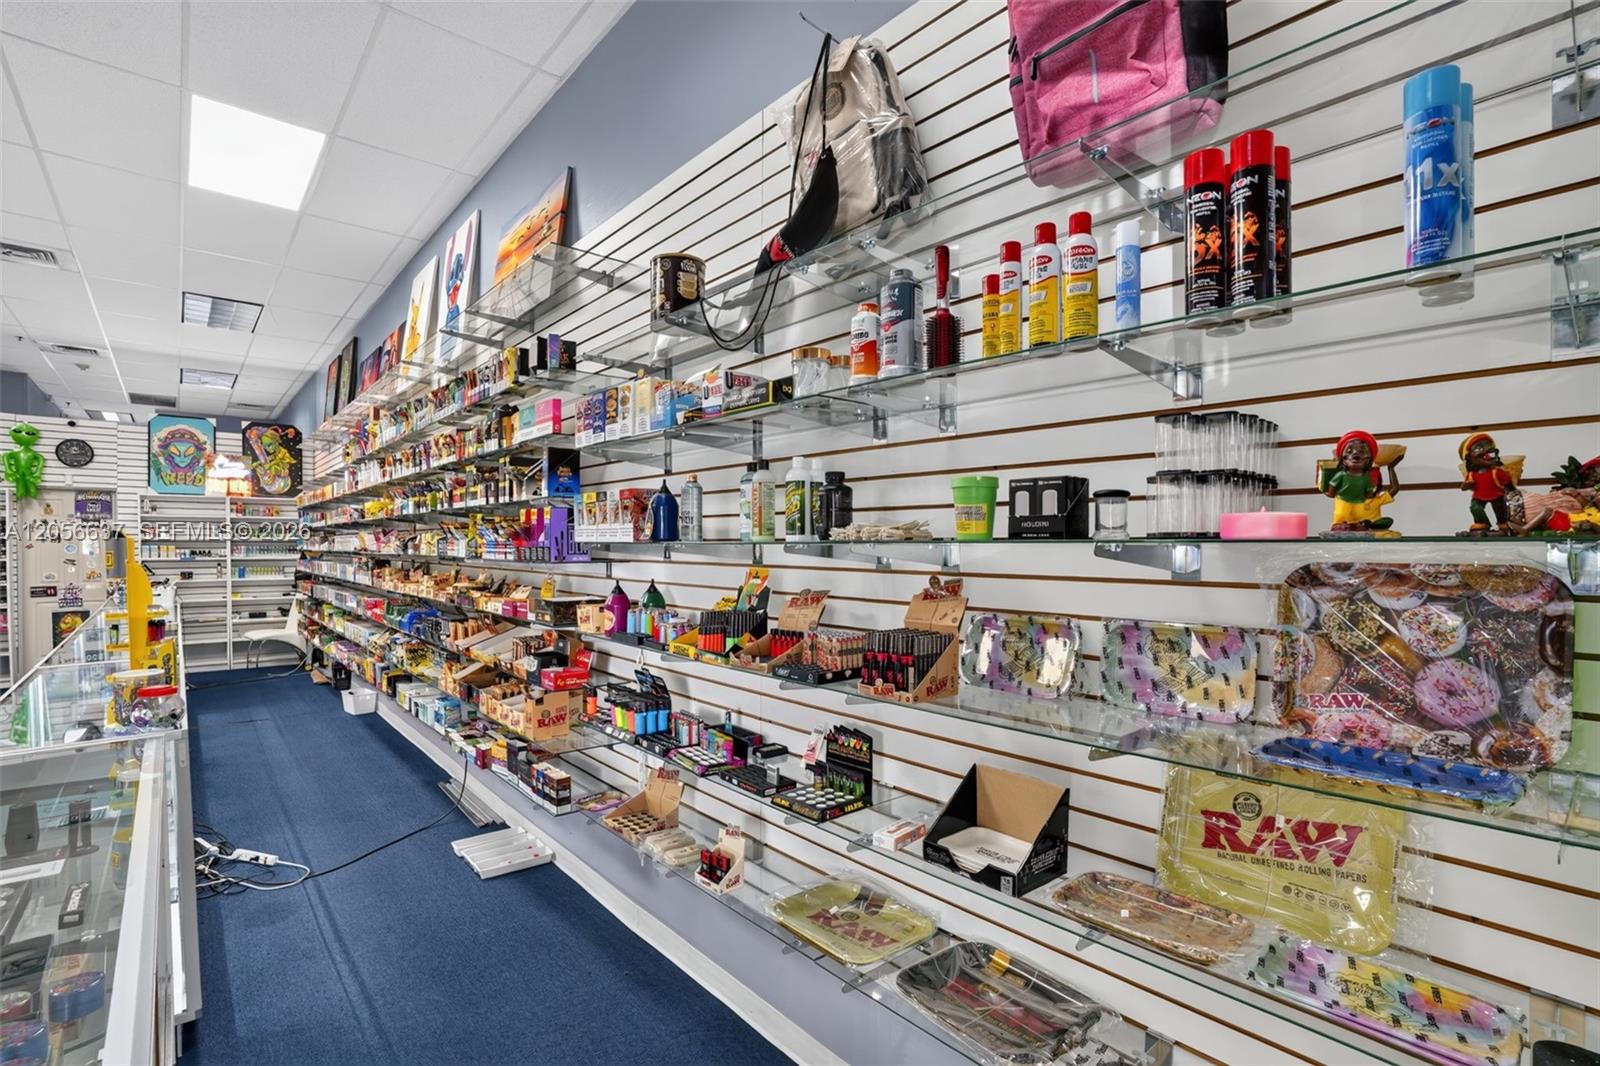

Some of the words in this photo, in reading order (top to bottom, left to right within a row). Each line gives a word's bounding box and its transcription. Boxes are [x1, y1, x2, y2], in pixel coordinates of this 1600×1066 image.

[788, 595, 826, 609] RAW
[873, 686, 894, 696] RAW
[926, 676, 948, 697] RAW
[1307, 692, 1367, 710] RAW
[537, 712, 568, 728] RAW
[1199, 808, 1365, 868] RAW
[1250, 855, 1295, 872] UNREFINED
[1297, 865, 1333, 879] ROLLING
[1334, 869, 1368, 884] PAPERS
